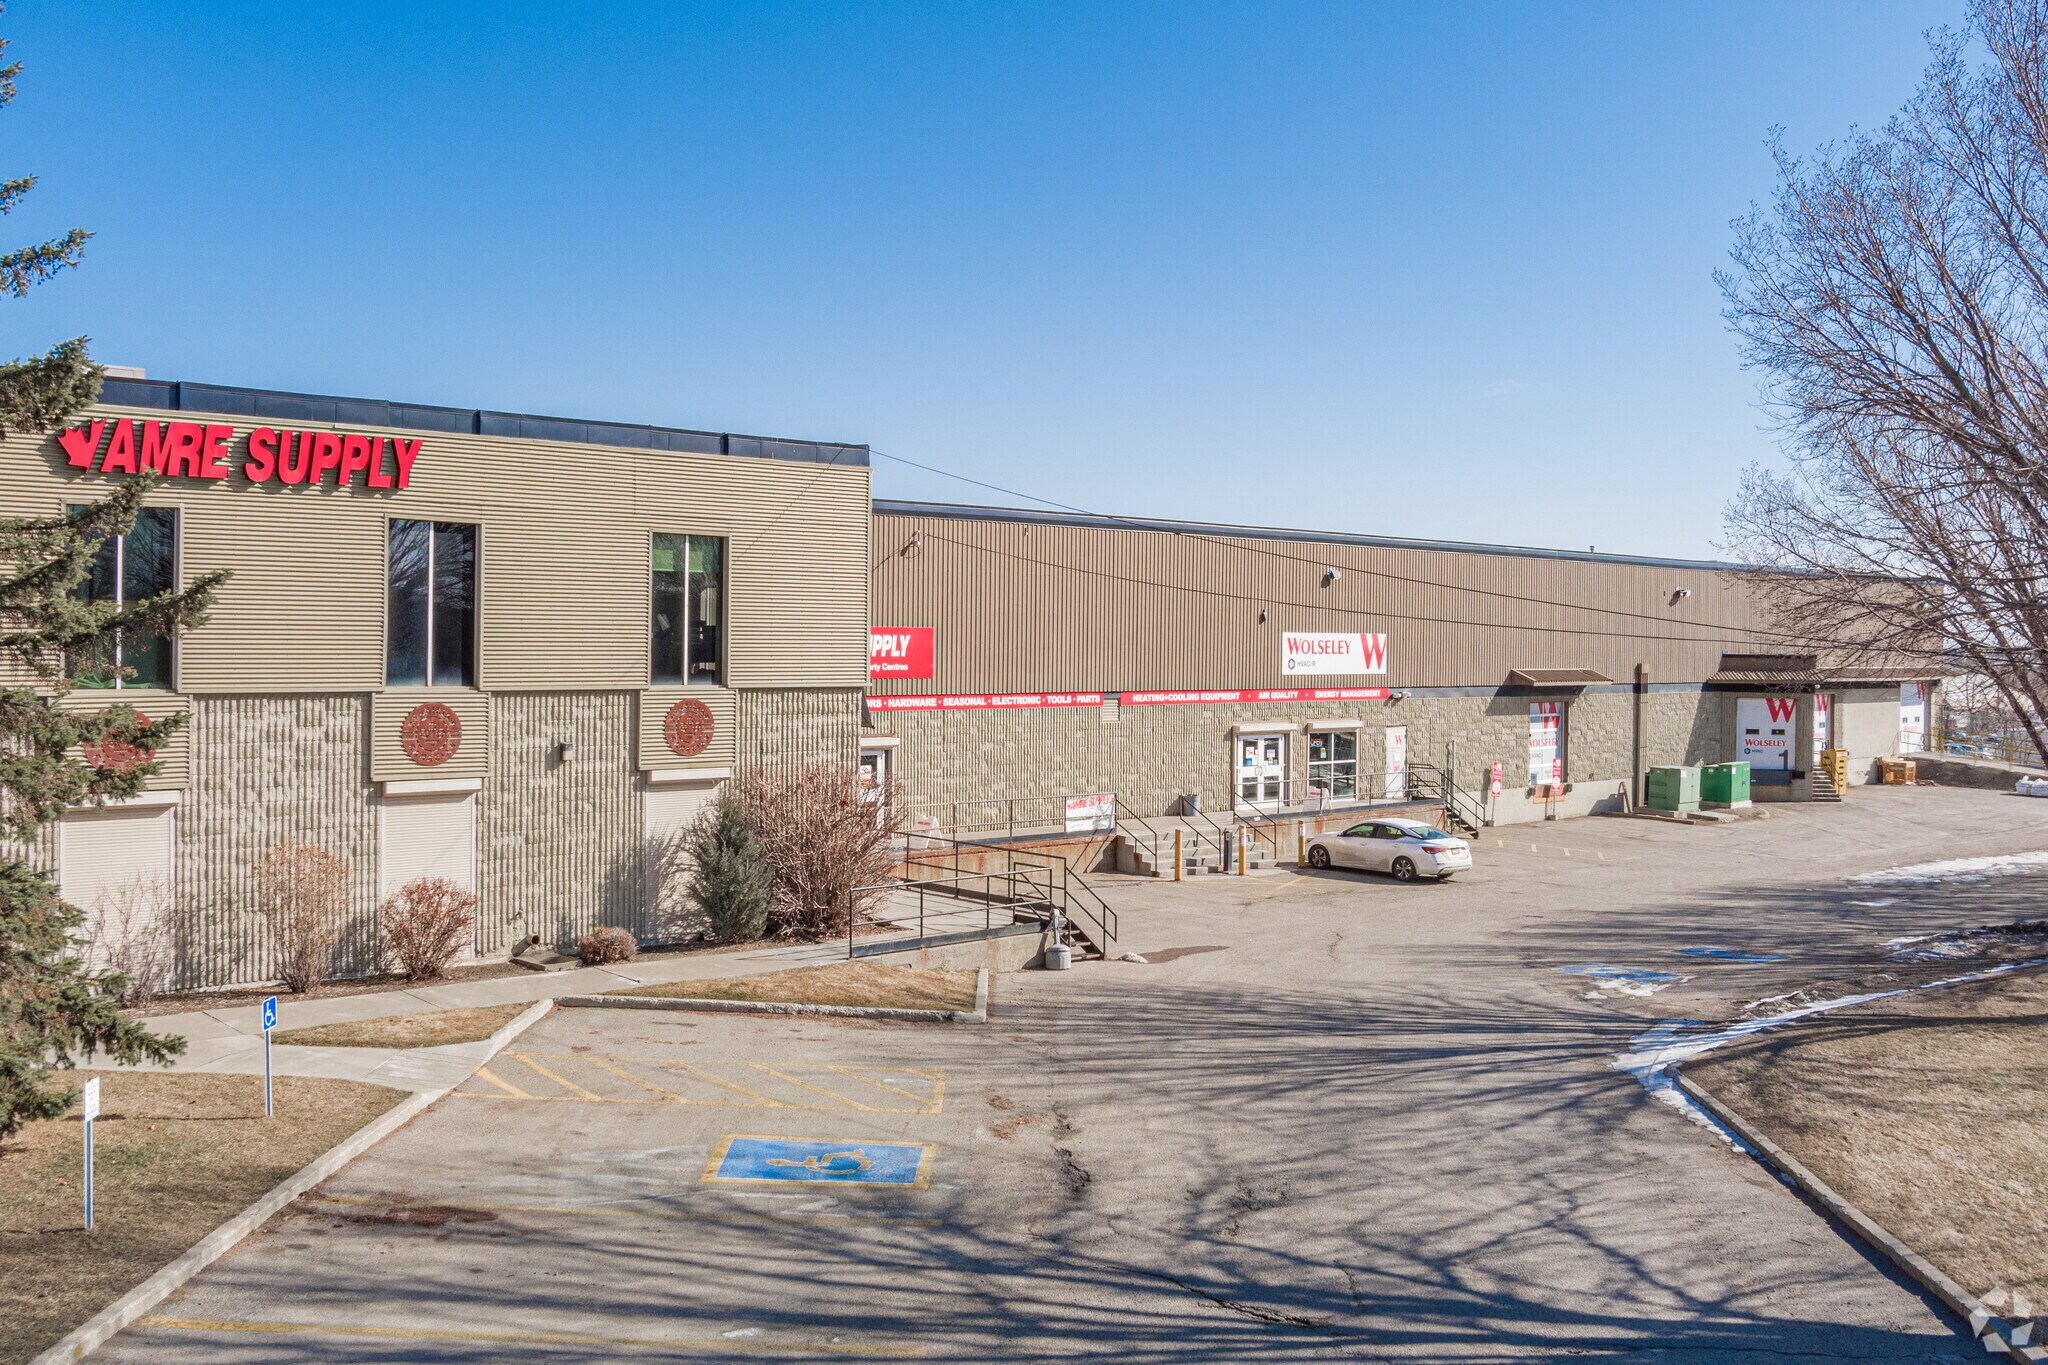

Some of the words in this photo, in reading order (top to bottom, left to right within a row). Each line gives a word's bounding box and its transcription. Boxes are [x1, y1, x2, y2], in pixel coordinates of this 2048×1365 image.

[101, 417, 234, 479] AMRE
[245, 426, 424, 490] SUPPLY
[1287, 637, 1352, 655] WOLSELEY
[1360, 633, 1387, 670] W
[882, 662, 909, 671] Centres
[888, 698, 937, 707] HARDWARE
[943, 696, 987, 706] SEASONAL
[991, 696, 1041, 705] ELECTRONIC
[1047, 695, 1072, 704] TOOLS
[1076, 694, 1101, 703] PARTS
[1132, 693, 1199, 702] HEATING+COOLING
[1200, 692, 1240, 701] EQUIPMENT
[1258, 691, 1270, 699] AIR
[1271, 691, 1298, 699] QUALITY
[1315, 690, 1339, 698] ENERGY
[1340, 689, 1381, 697] MANAGEMENT
[1765, 697, 1797, 723] W
[1744, 738, 1787, 747] WOLSELEY
